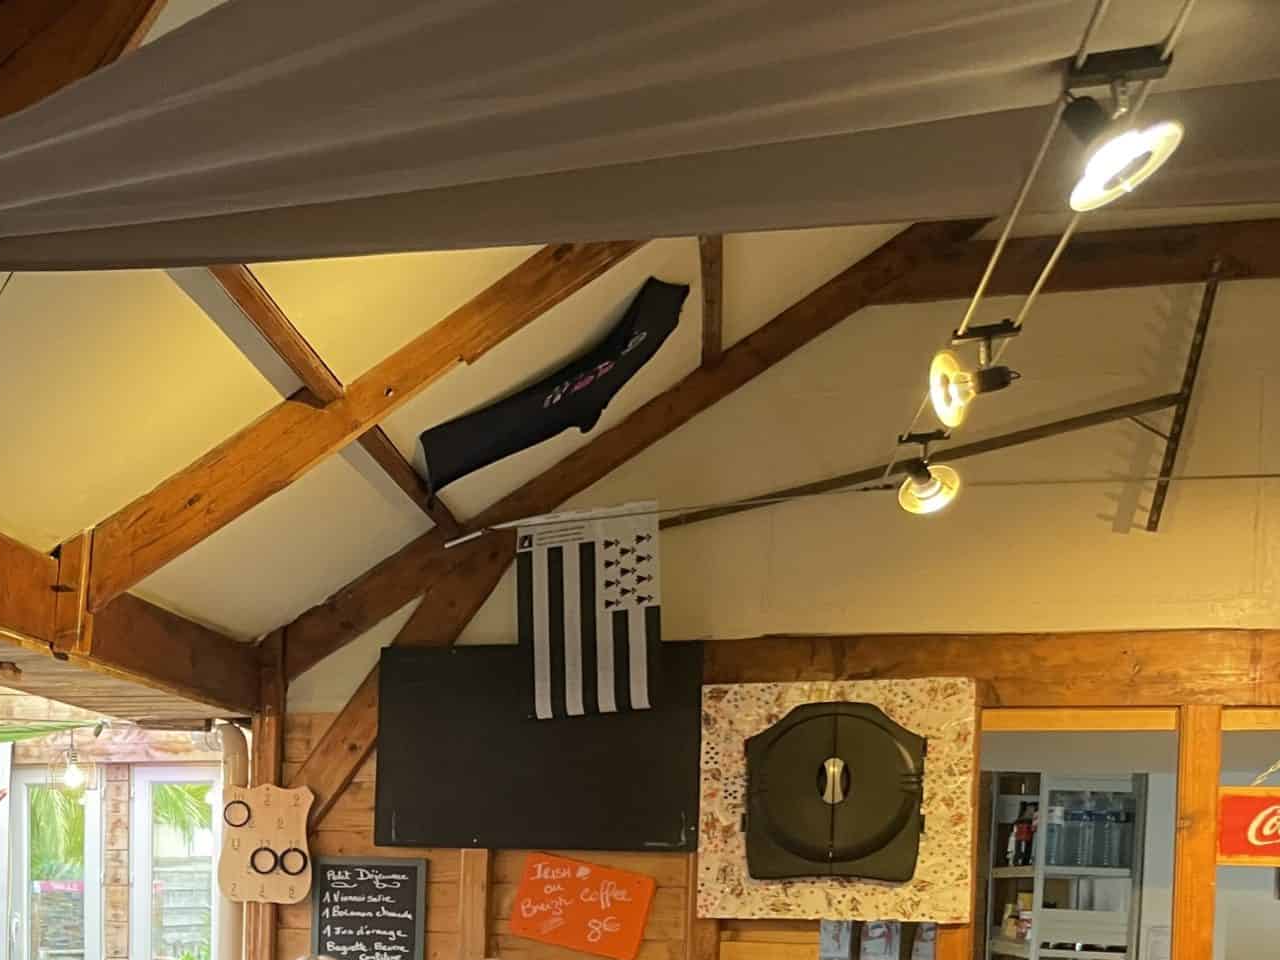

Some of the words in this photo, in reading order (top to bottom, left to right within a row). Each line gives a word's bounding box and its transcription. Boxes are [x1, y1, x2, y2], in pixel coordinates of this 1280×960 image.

[1248, 805, 1280, 846] Co
[322, 890, 331, 904] 1
[321, 907, 330, 919] 1
[322, 924, 332, 937] 1
